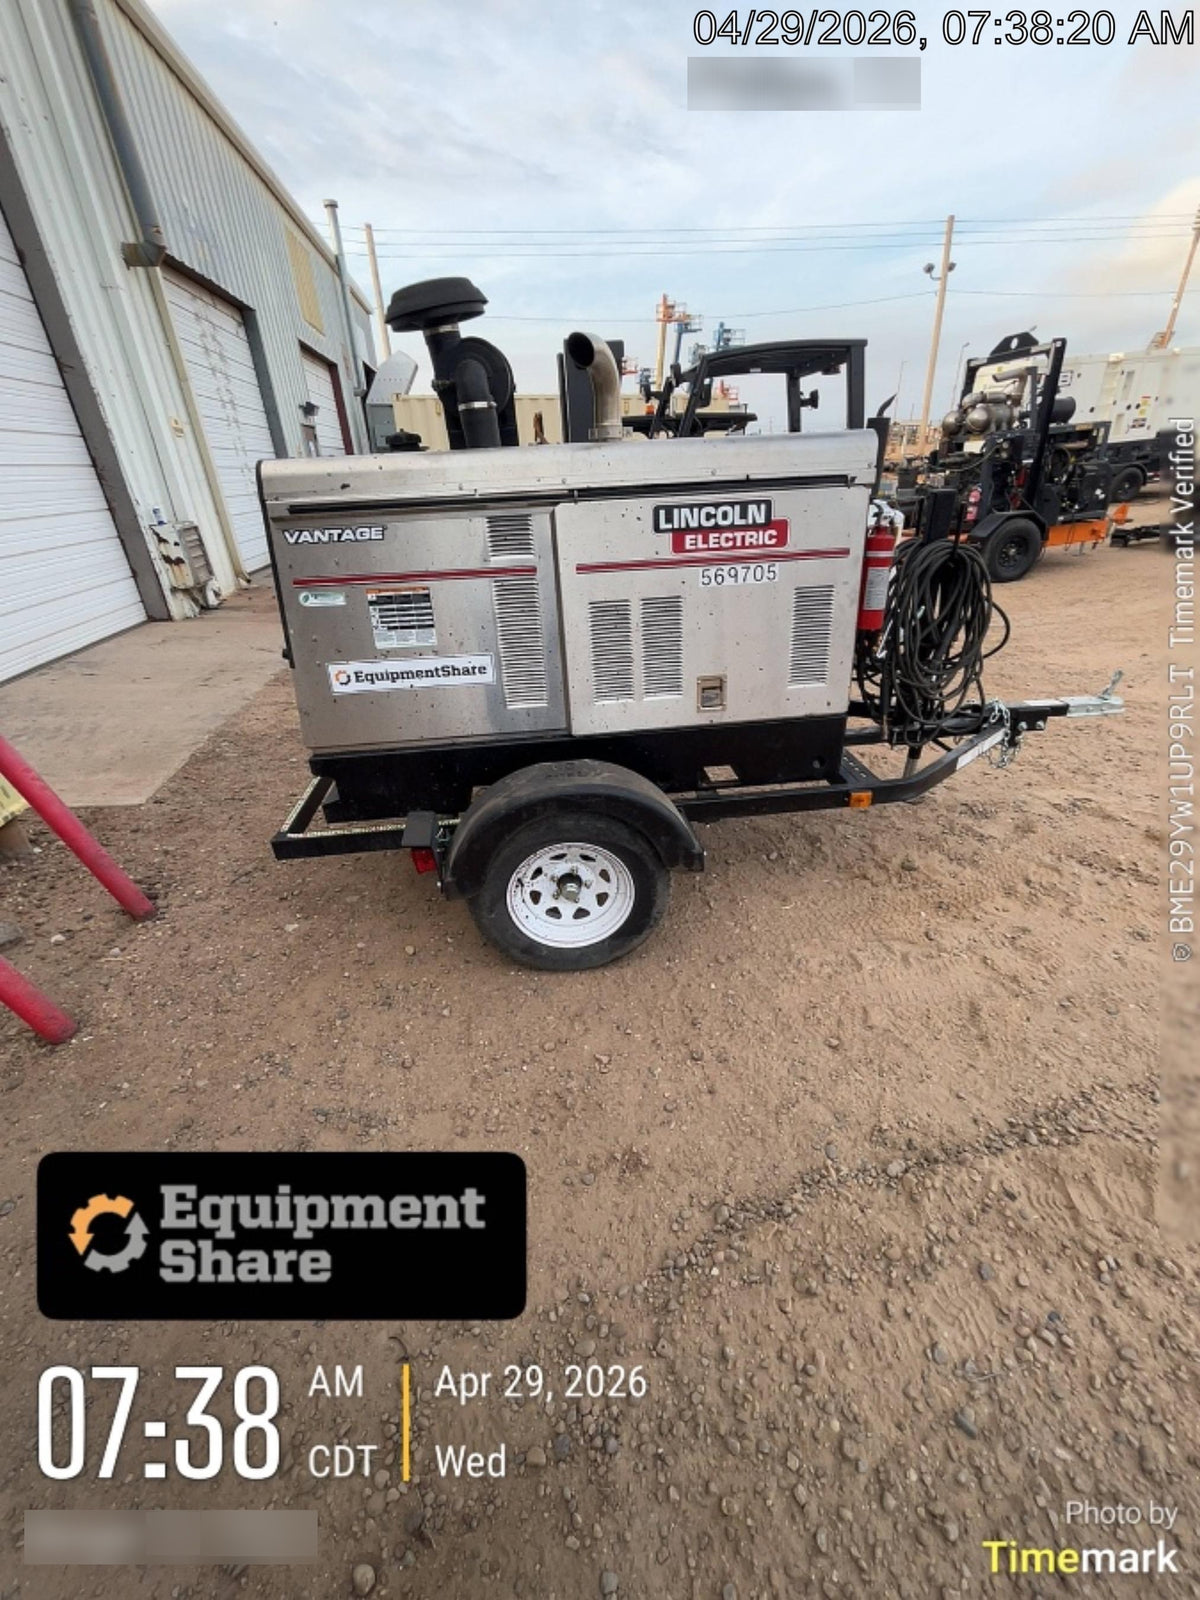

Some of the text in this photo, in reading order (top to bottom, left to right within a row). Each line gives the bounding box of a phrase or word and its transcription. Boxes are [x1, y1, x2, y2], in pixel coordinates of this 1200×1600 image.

[658, 502, 767, 530] LINCOLN
[284, 526, 385, 544] VANTAGE
[684, 529, 778, 550] ELECTRIC
[701, 564, 777, 586] 569705
[354, 663, 487, 684] EquipmentShare
